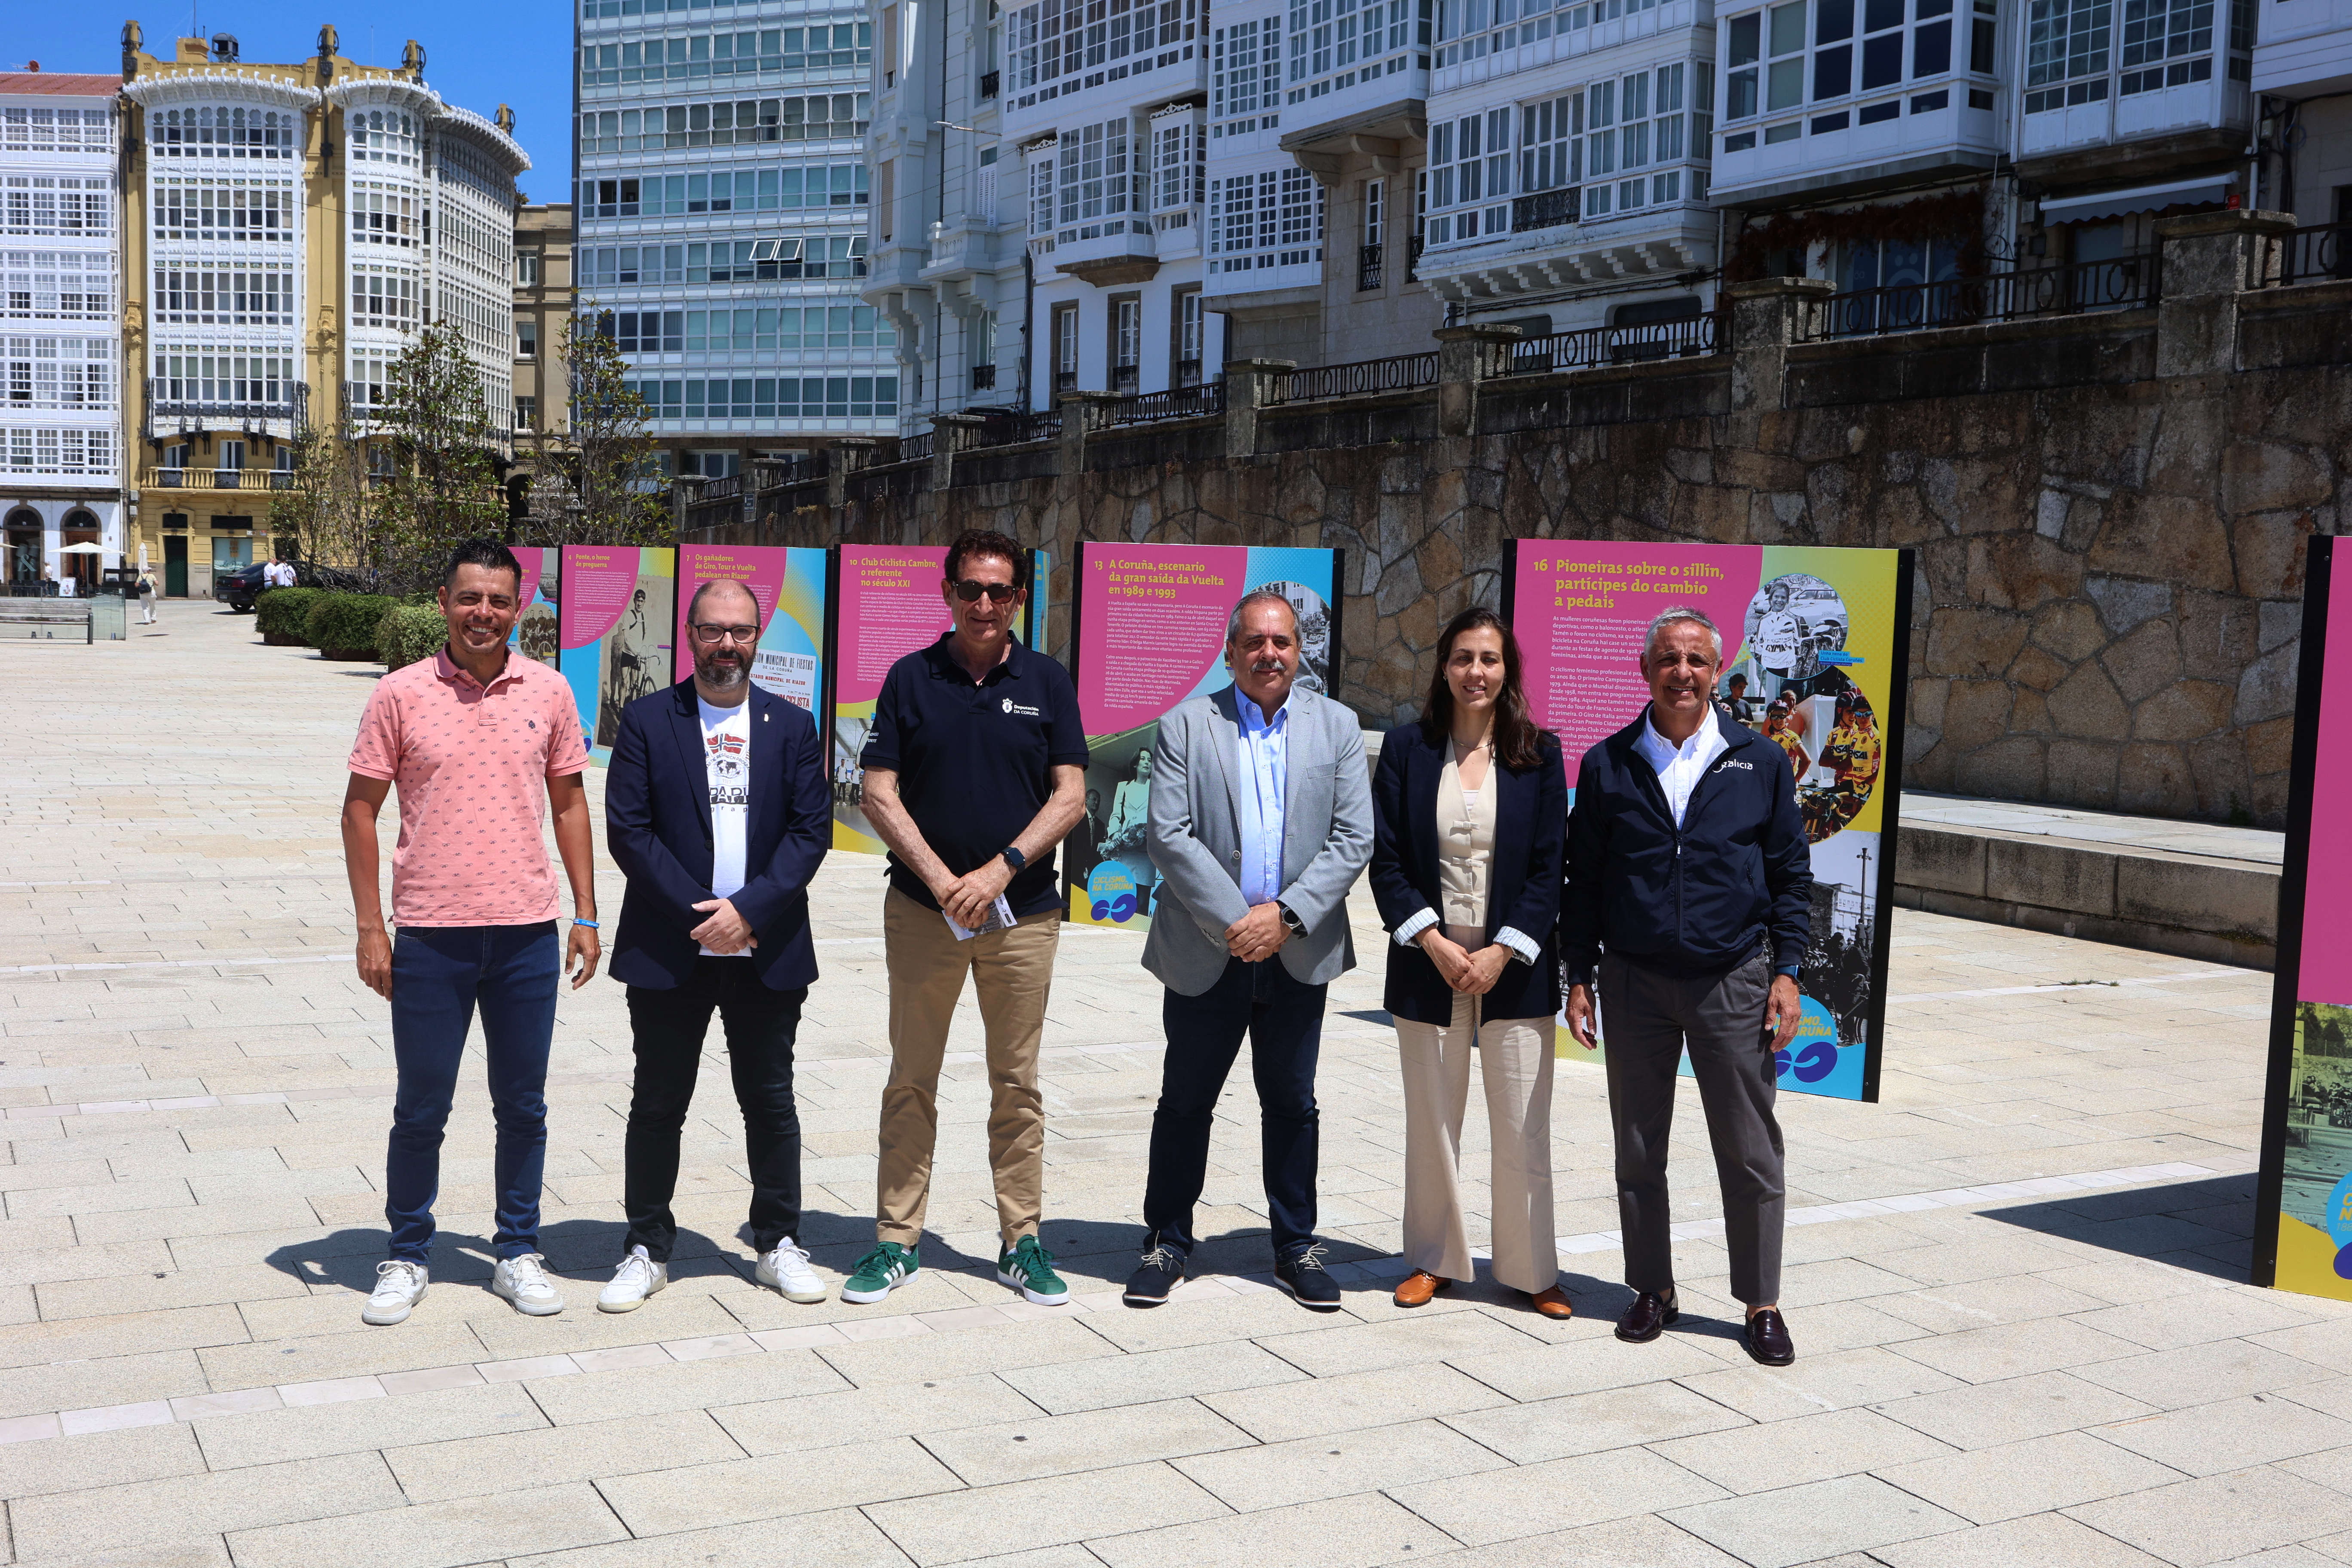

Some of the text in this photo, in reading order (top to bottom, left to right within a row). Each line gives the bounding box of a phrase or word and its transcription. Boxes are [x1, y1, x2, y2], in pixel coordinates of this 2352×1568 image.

[861, 557, 878, 566] Club
[880, 558, 906, 567] Ciclista
[908, 559, 938, 569] Cambre,
[1094, 559, 1205, 572] 13 A Coruña, escenario
[1534, 559, 1724, 580] 16 Pioneiras sobre o sillín,
[867, 569, 902, 577] referente
[1109, 572, 1224, 585] da gran saída da Vuelta
[873, 579, 896, 587] século
[1555, 577, 1708, 595] partícipes do cambio
[1123, 585, 1144, 597] 1989
[1155, 588, 1176, 598] 1993
[1554, 594, 1614, 610] a pedais
[754, 652, 813, 671] SIÓN MUNICIPAL DE FIESTAS
[786, 695, 809, 707] CICLISTA
[1712, 759, 1753, 773] galicia
[710, 786, 749, 803] PAPI
